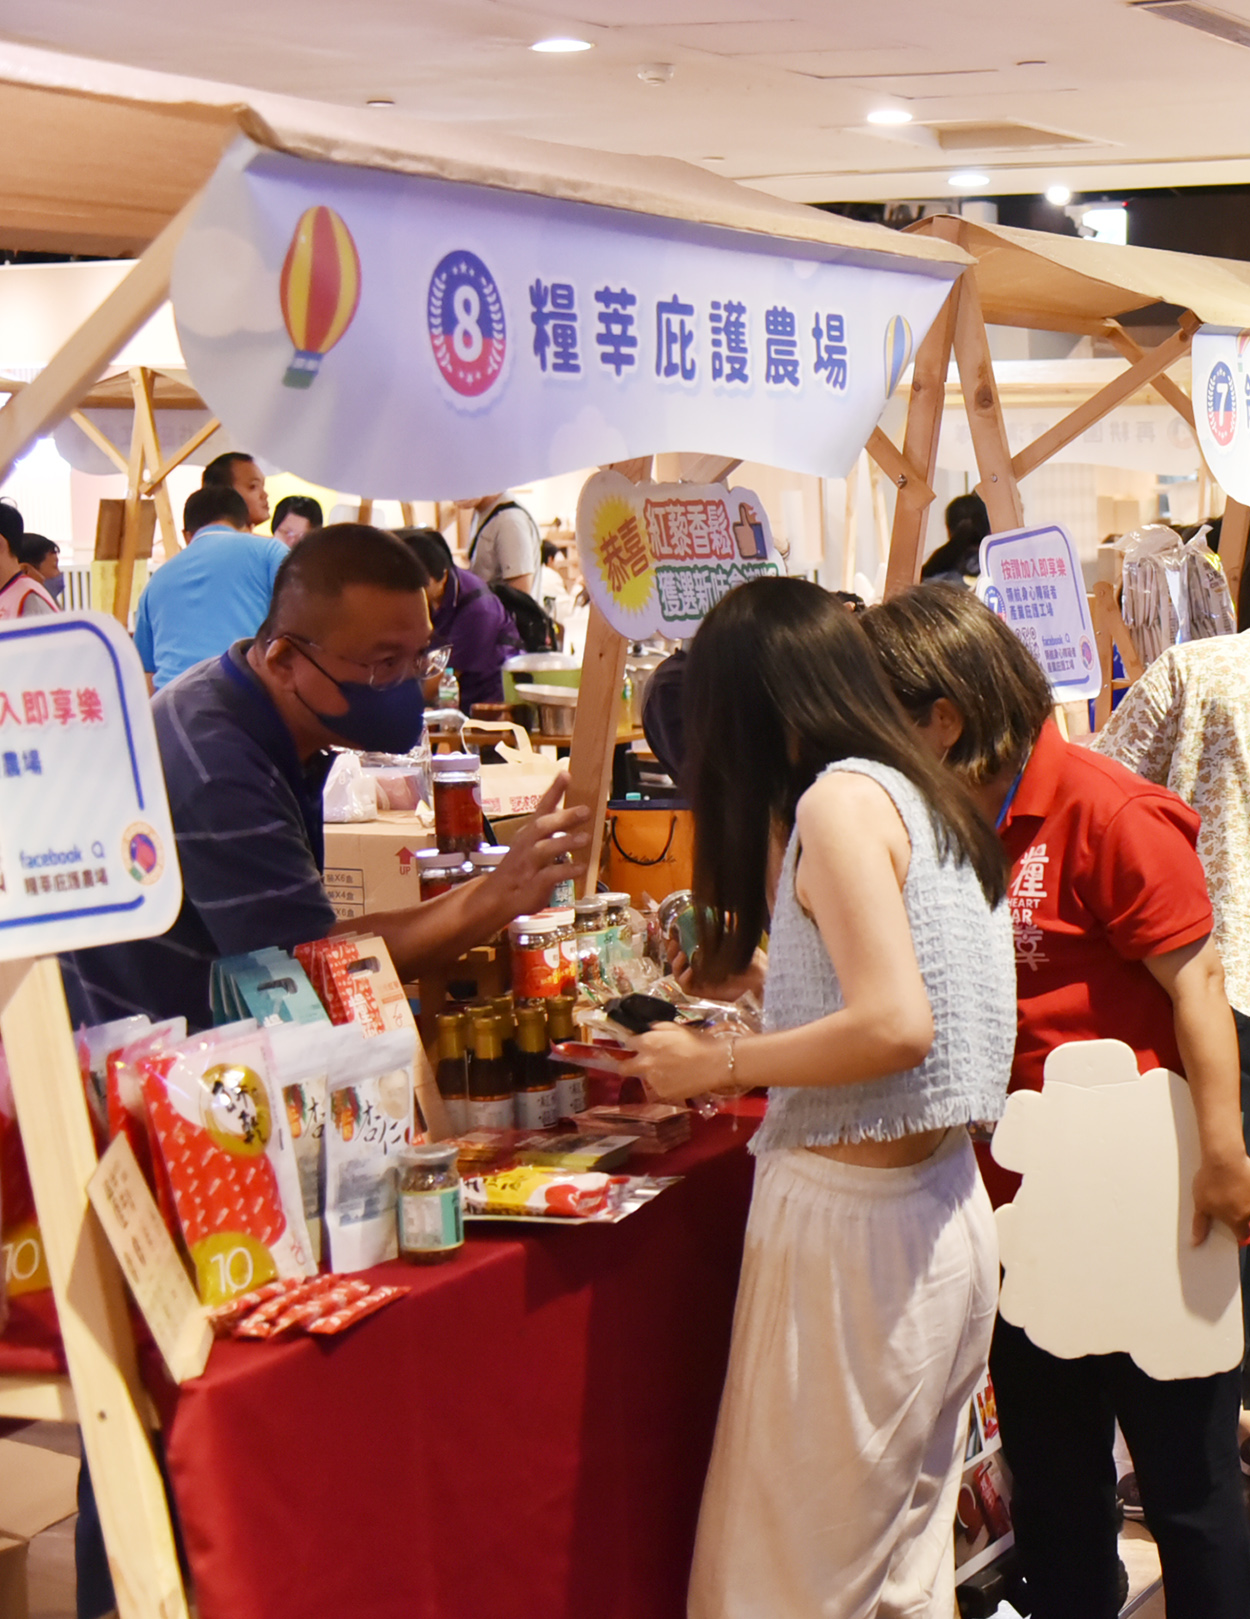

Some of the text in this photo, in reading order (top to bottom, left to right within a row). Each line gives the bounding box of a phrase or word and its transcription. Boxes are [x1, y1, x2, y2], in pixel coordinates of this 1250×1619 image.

[453, 284, 483, 362] 8
[528, 277, 848, 391] 糧莘庇護農場
[599, 515, 650, 593] 恭喜
[646, 501, 733, 558] 紅藜香鬆
[657, 567, 777, 617] 獲選新味
[19, 841, 82, 869] facebook
[0, 1238, 40, 1283] 10
[210, 1246, 254, 1294] 10
